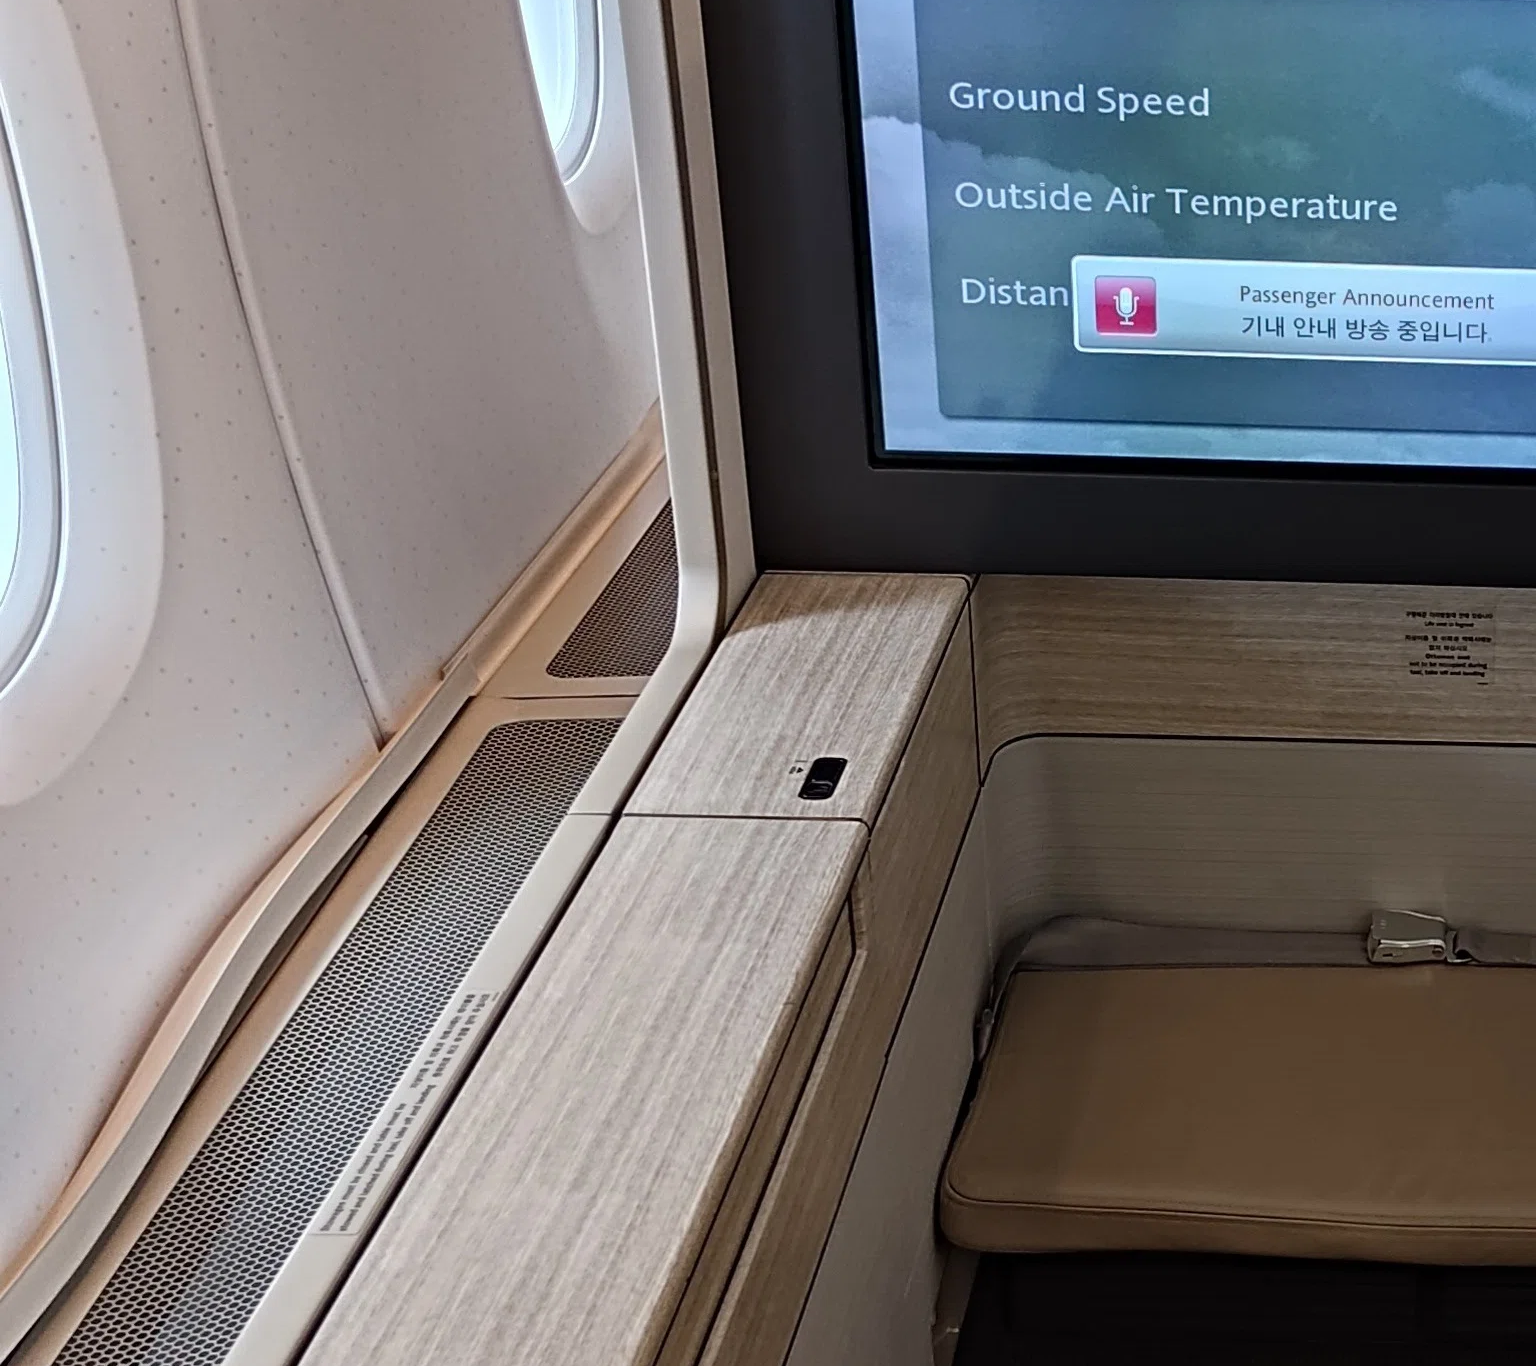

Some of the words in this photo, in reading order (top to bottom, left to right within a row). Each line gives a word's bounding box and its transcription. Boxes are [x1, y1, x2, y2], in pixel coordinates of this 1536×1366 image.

[949, 81, 1086, 114] Ground
[1097, 86, 1211, 122] Speed
[954, 181, 1092, 213] Outside
[1104, 185, 1156, 215] Air
[1165, 188, 1398, 224] Temperature
[961, 277, 1069, 308] Distan
[1240, 285, 1336, 308] Passenger
[1342, 288, 1495, 310] Announcement
[1241, 316, 1285, 338] 기내
[1293, 317, 1337, 339] 안내
[1346, 318, 1390, 341] 방송
